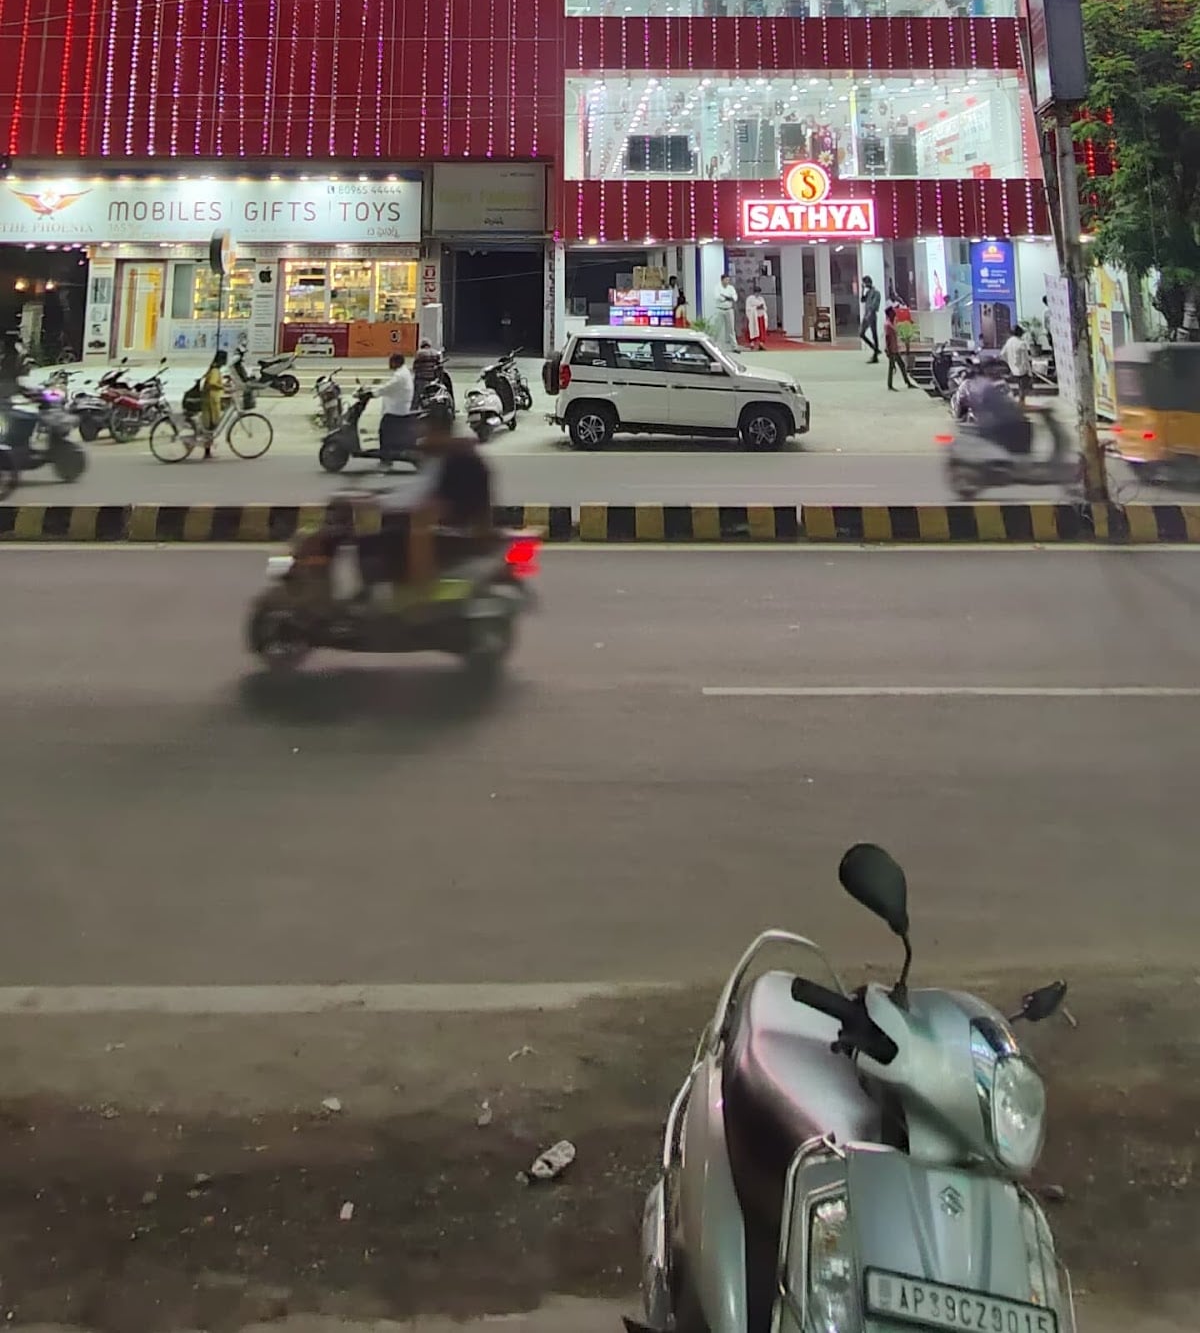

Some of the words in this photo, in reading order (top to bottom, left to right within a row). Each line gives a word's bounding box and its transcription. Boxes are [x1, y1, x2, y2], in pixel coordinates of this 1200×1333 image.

[107, 201, 222, 222] MOBILES
[244, 201, 317, 222] GIFTS
[338, 201, 401, 222] TOYS
[749, 205, 869, 230] SATHYA
